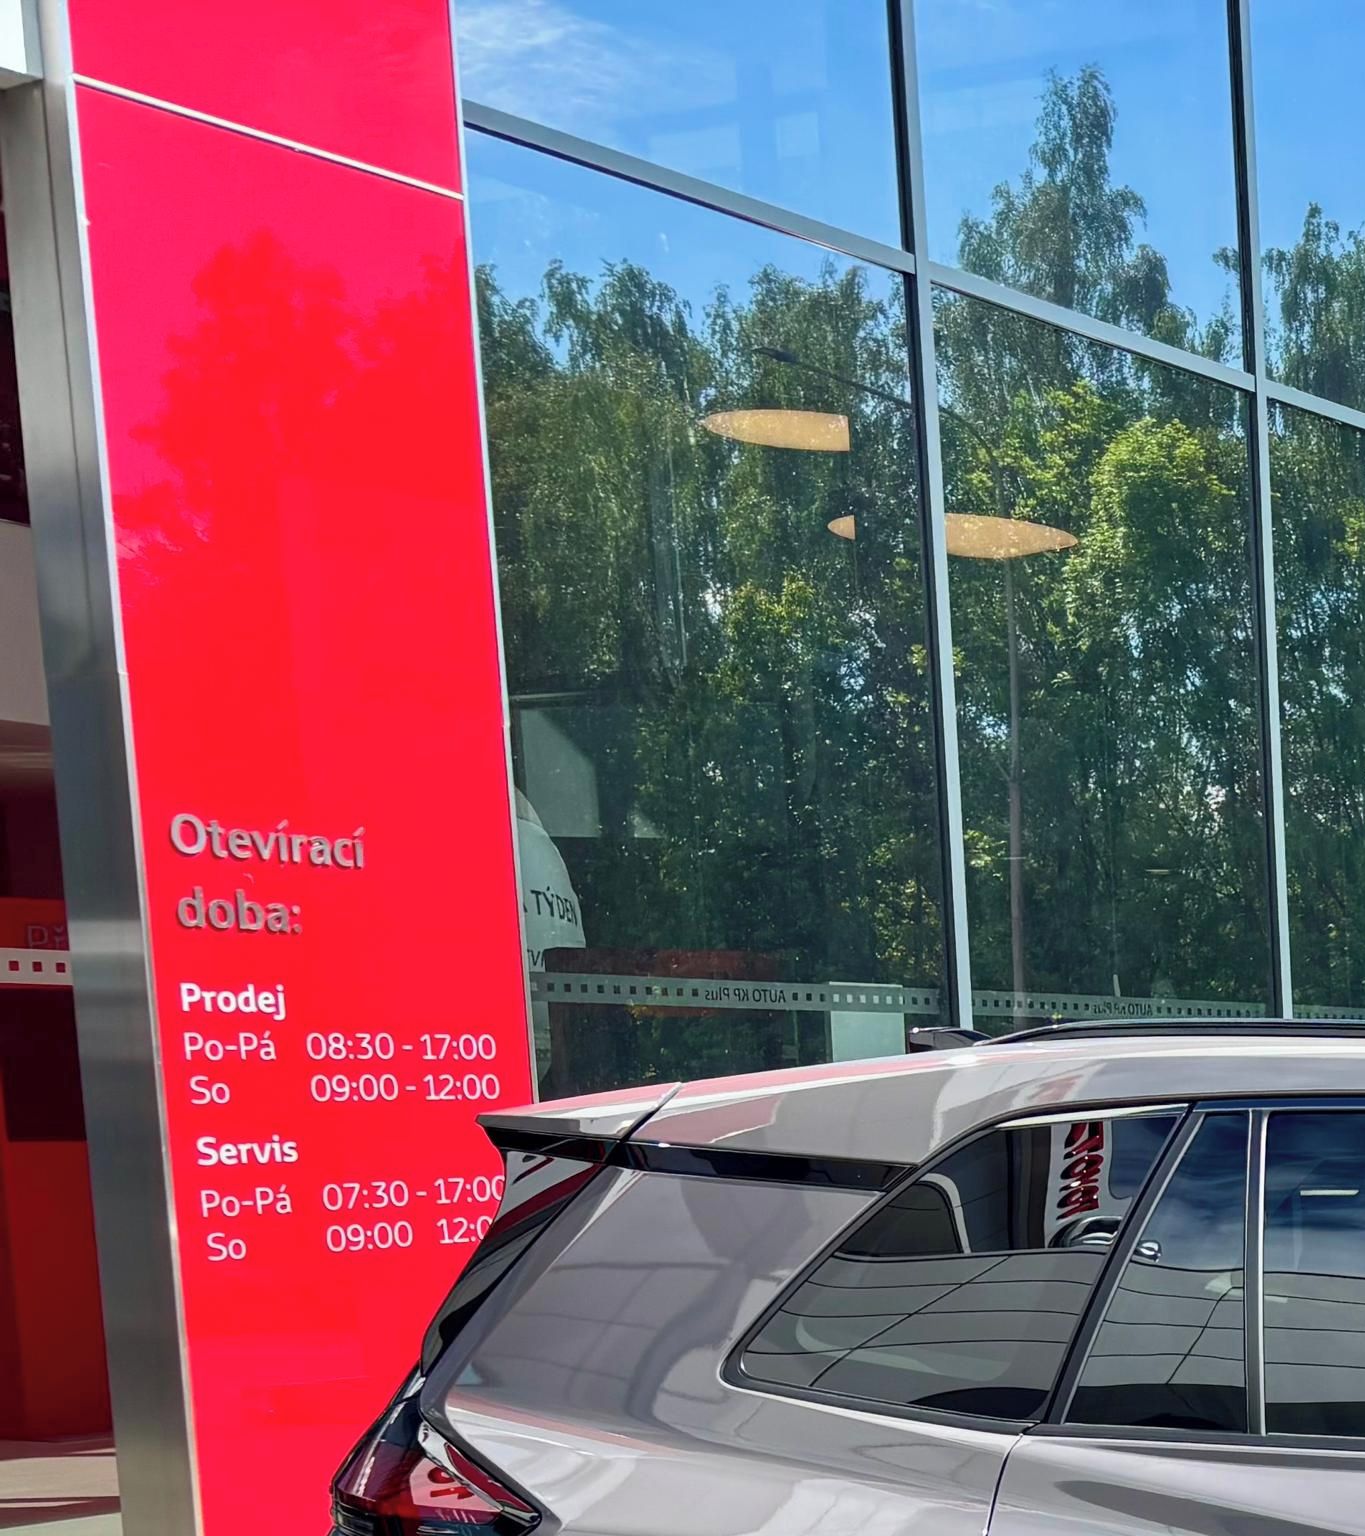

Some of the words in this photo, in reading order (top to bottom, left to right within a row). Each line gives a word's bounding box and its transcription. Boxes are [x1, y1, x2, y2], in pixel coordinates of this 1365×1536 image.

[170, 813, 366, 869] Otevírací
[176, 887, 303, 935] doba:
[180, 983, 287, 1021] Prodej
[184, 1030, 277, 1061] Po-Pá
[306, 1033, 395, 1061] 08:30
[420, 1034, 497, 1061] 17:00
[190, 1076, 231, 1105] So
[310, 1075, 399, 1102] 09:00
[423, 1074, 500, 1102] 12:00
[197, 1135, 299, 1166] Servis
[200, 1185, 293, 1218] Po-Pá
[322, 1182, 410, 1211] 07:30
[207, 1233, 247, 1261] So
[326, 1222, 414, 1253] 09:00
[436, 1214, 494, 1244] 12:0
